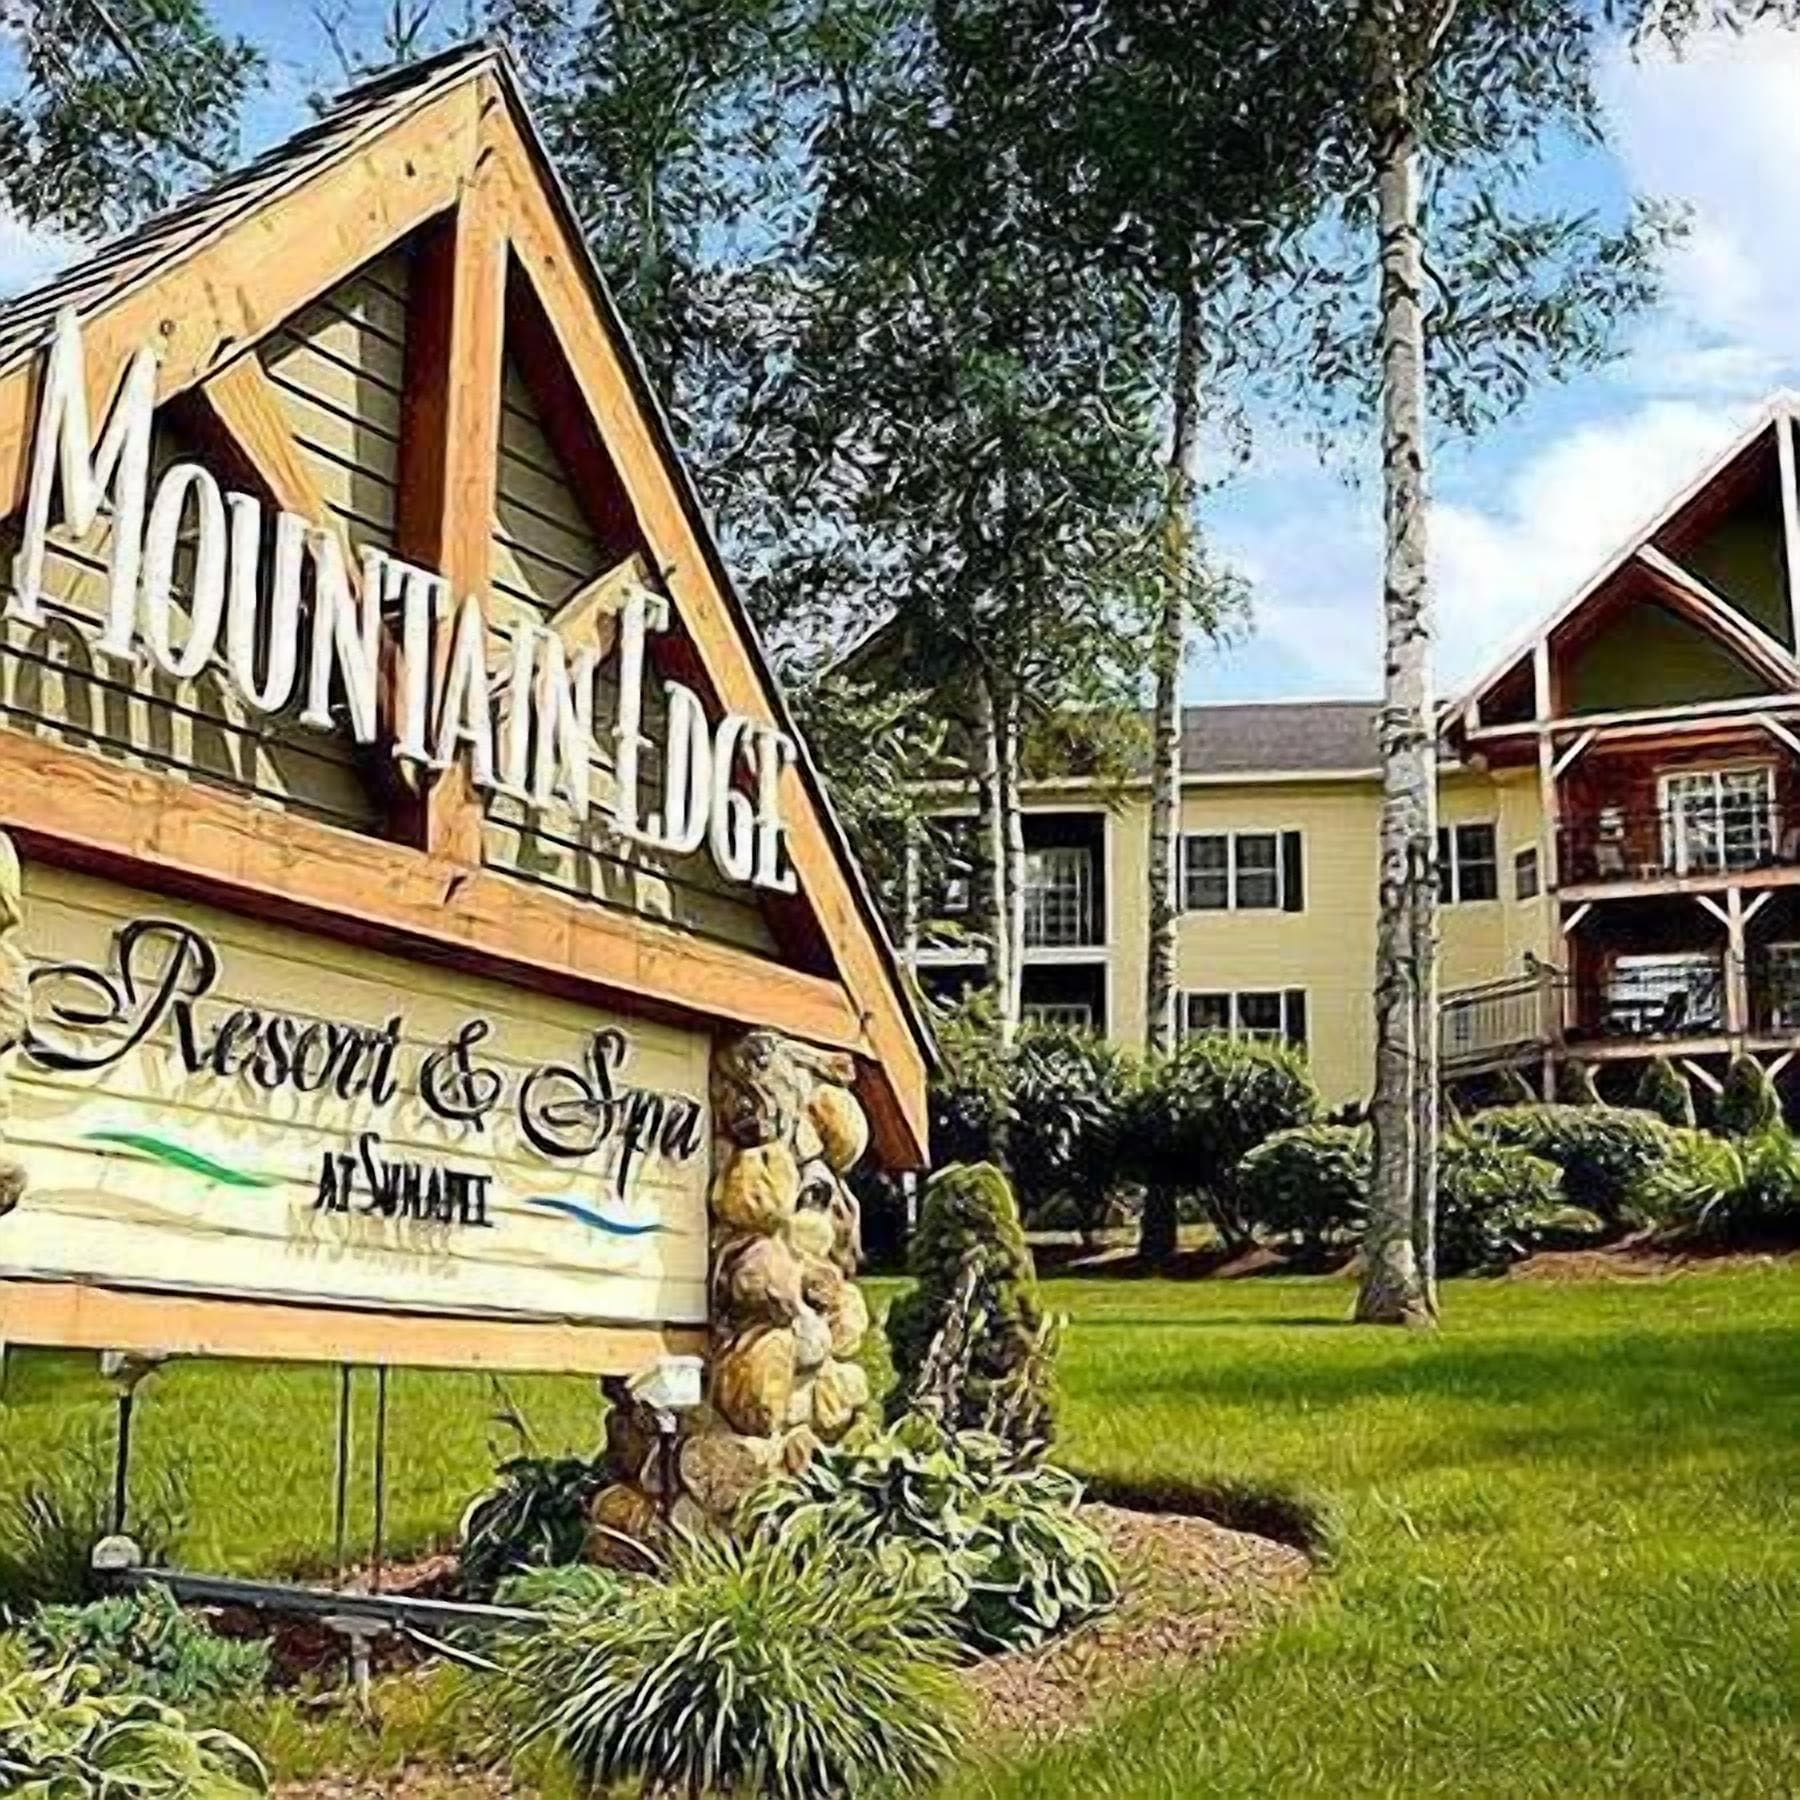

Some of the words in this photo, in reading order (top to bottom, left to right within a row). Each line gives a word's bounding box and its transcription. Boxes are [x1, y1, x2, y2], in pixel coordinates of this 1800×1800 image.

[20, 917, 403, 1107] Resort
[418, 1019, 501, 1132] &
[518, 1024, 702, 1200] Spa
